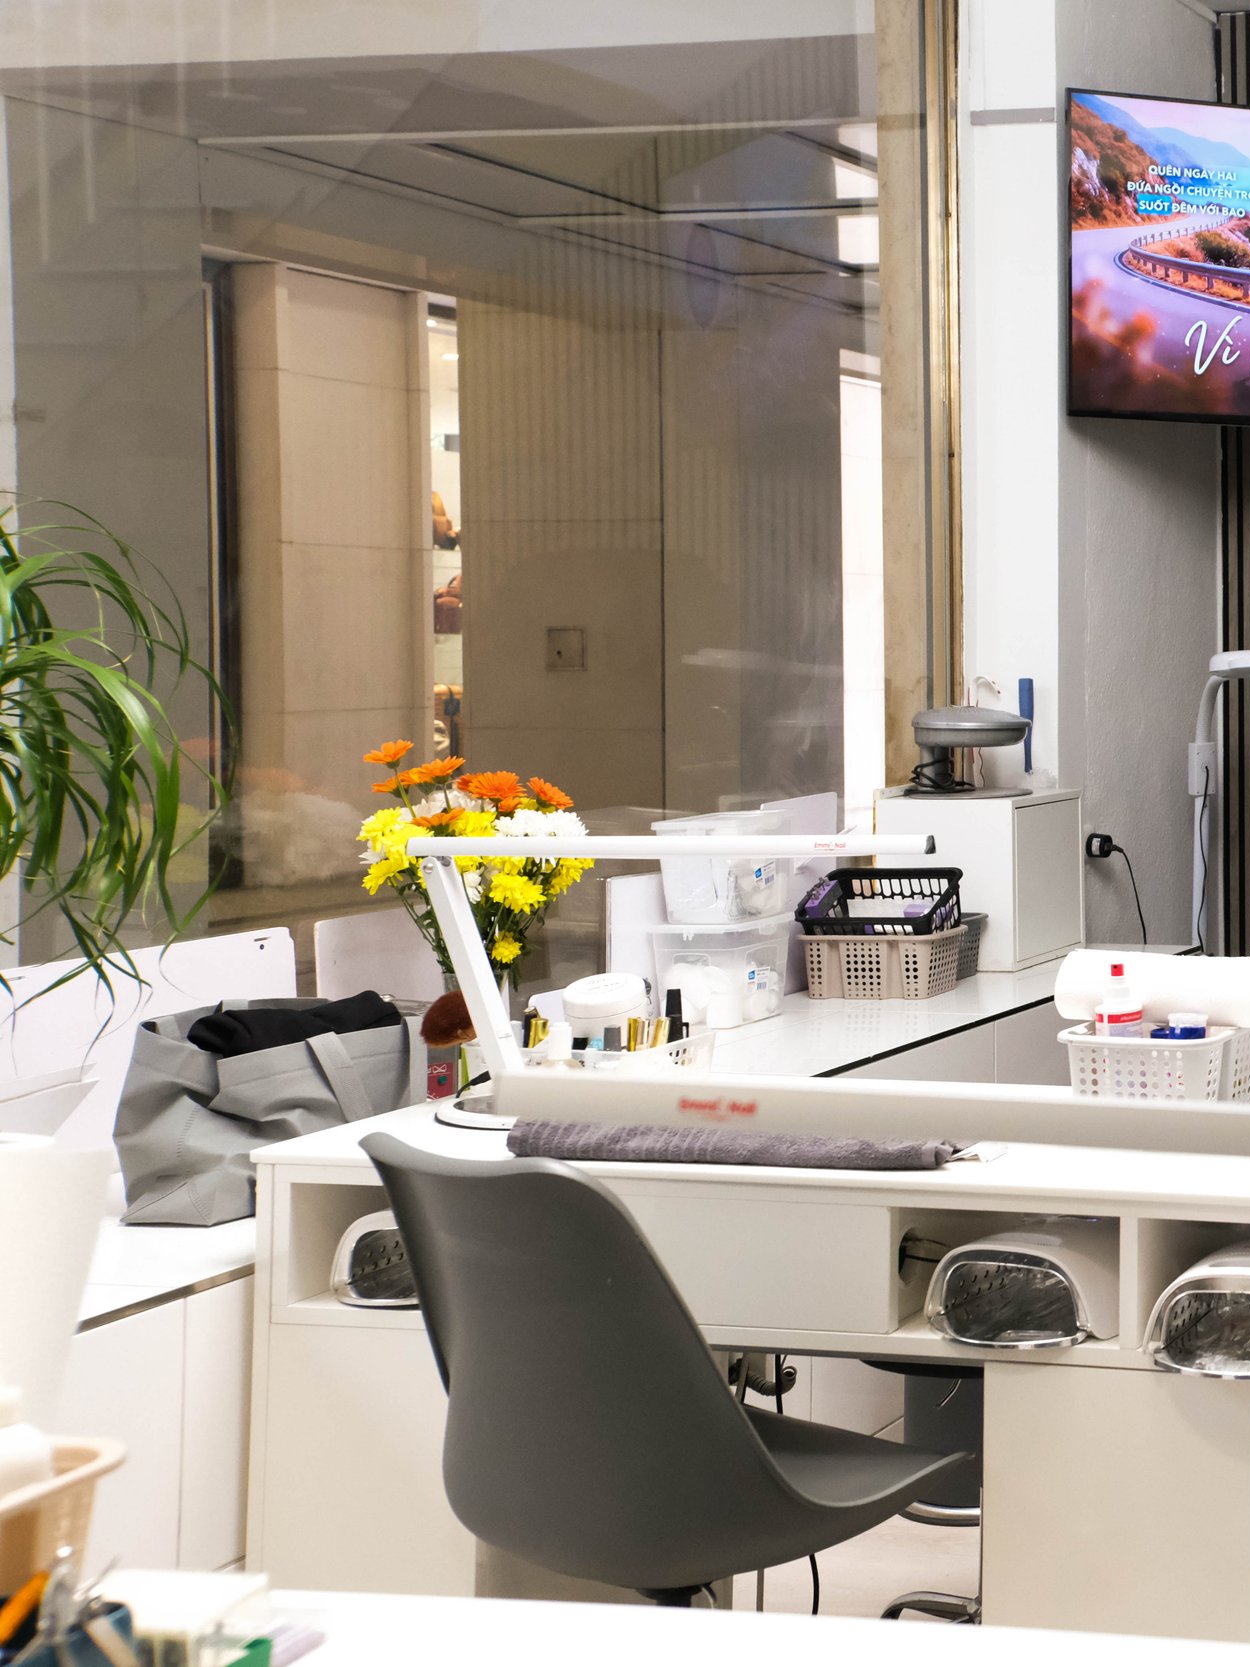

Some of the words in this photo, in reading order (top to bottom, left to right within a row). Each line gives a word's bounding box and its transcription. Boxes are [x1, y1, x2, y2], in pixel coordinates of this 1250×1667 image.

[1148, 164, 1181, 177] QUÊN
[1217, 171, 1237, 181] HAI
[1127, 179, 1152, 192] ĐỨA
[1155, 181, 1184, 195] NGỒI
[1187, 185, 1232, 200] CHUYỆN
[1139, 198, 1169, 211] SUỐT
[1172, 201, 1197, 214] ĐÊM
[1200, 203, 1219, 215] VỚI
[1221, 207, 1246, 218] BAO
[1184, 315, 1243, 375] Vì
